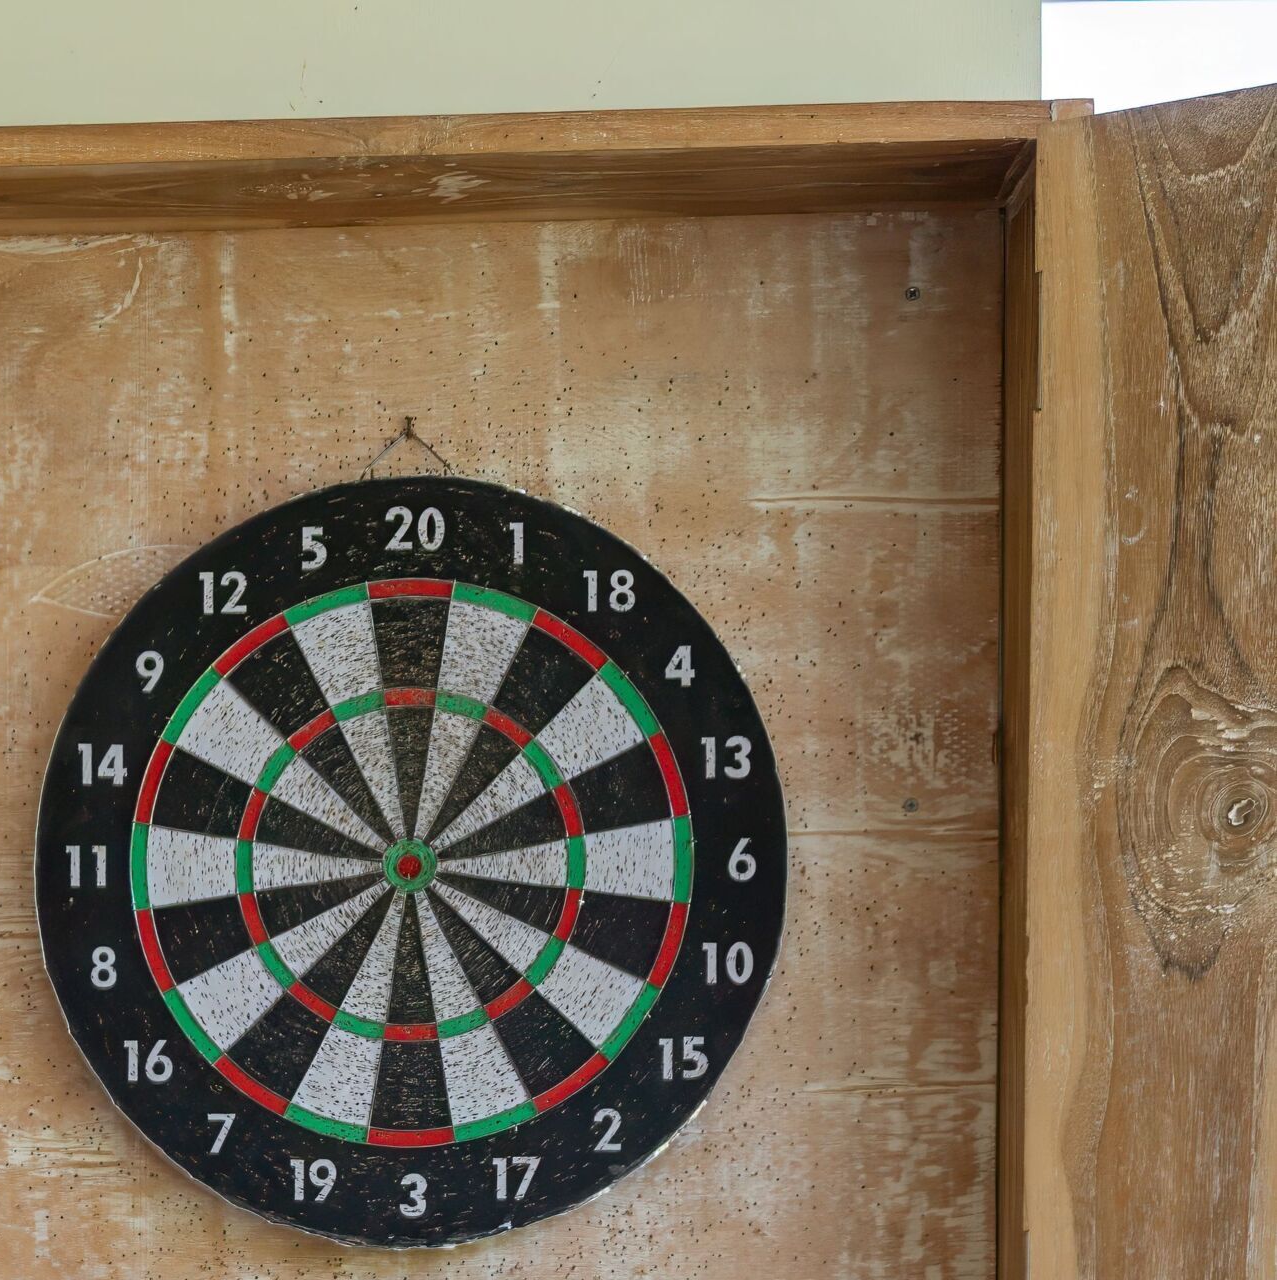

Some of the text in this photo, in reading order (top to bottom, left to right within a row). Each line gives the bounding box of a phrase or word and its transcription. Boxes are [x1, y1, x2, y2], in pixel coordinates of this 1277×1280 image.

[301, 526, 328, 572] 5
[384, 506, 446, 551] 20
[509, 521, 524, 565] 1
[198, 571, 247, 614] 12
[582, 569, 636, 612] 18
[135, 650, 165, 693] 9
[665, 644, 695, 687] 4
[78, 742, 128, 786] 14
[701, 736, 752, 780] 13
[65, 845, 107, 887] 11
[727, 837, 757, 880] 6
[89, 946, 117, 989] 8
[701, 941, 754, 984] 10
[123, 1039, 174, 1084] 16
[659, 1037, 710, 1080] 15
[208, 1112, 238, 1156] 7
[594, 1107, 623, 1152] 2
[289, 1158, 338, 1202] 19
[399, 1173, 428, 1217] 3
[492, 1156, 542, 1199] 17
